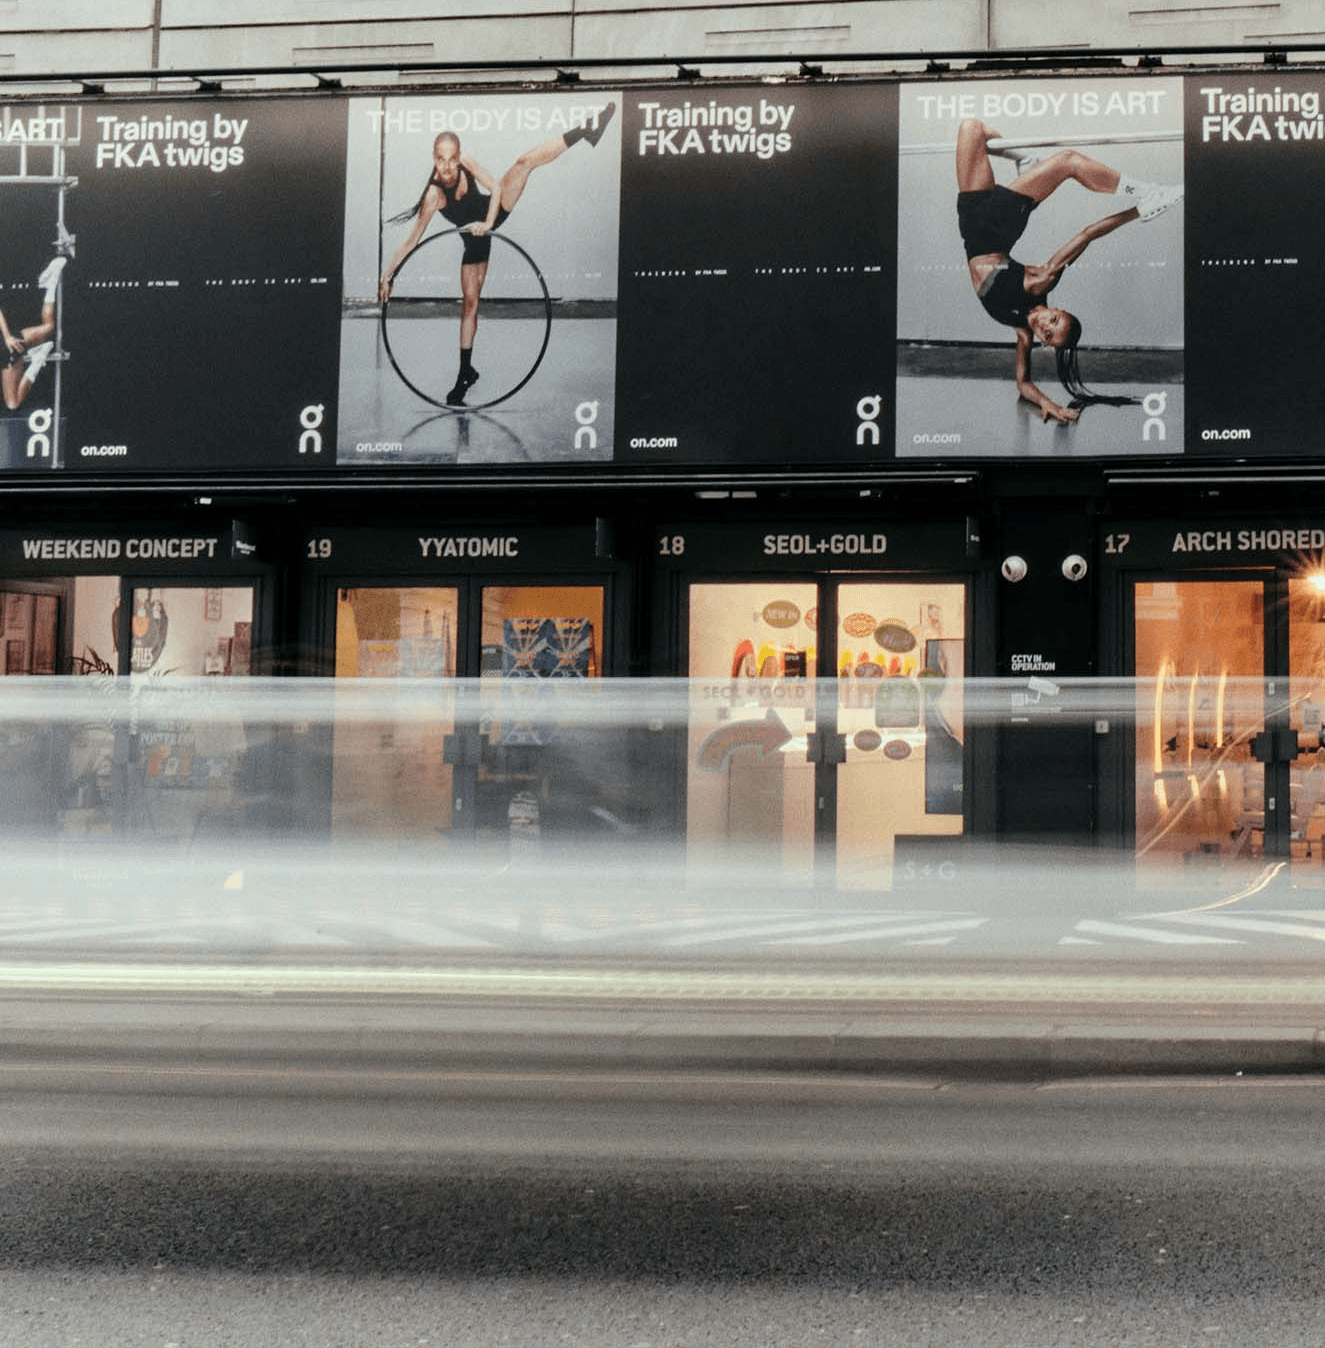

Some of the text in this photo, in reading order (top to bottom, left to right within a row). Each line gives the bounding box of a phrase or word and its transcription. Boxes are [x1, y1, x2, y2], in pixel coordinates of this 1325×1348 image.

[916, 90, 1167, 119] THE BODY IS ART
[1200, 86, 1319, 119] Training
[365, 105, 607, 134] THE BODY IS ART
[638, 99, 795, 132] Training by
[6, 118, 65, 142] ART
[96, 113, 248, 145] Training by
[1202, 115, 1272, 142] FKA
[639, 127, 792, 159] FKA twigs
[96, 141, 244, 172] FKA twigs
[630, 437, 677, 449] on.com
[913, 433, 961, 444] on.com
[1201, 428, 1250, 440] on.com
[81, 445, 127, 457] on.com
[356, 442, 402, 452] on.com
[23, 539, 121, 559] WEEKEND
[125, 539, 218, 558] CONCEPT
[307, 540, 332, 558] 19
[418, 537, 518, 557] YYATOMIC
[659, 536, 685, 555] 18
[763, 534, 887, 555] SEOL+GOLD
[1105, 534, 1130, 553] 17
[1172, 531, 1232, 552] ARCH
[1011, 654, 1042, 663] CCTV IN
[1011, 662, 1056, 671] OPERATION
